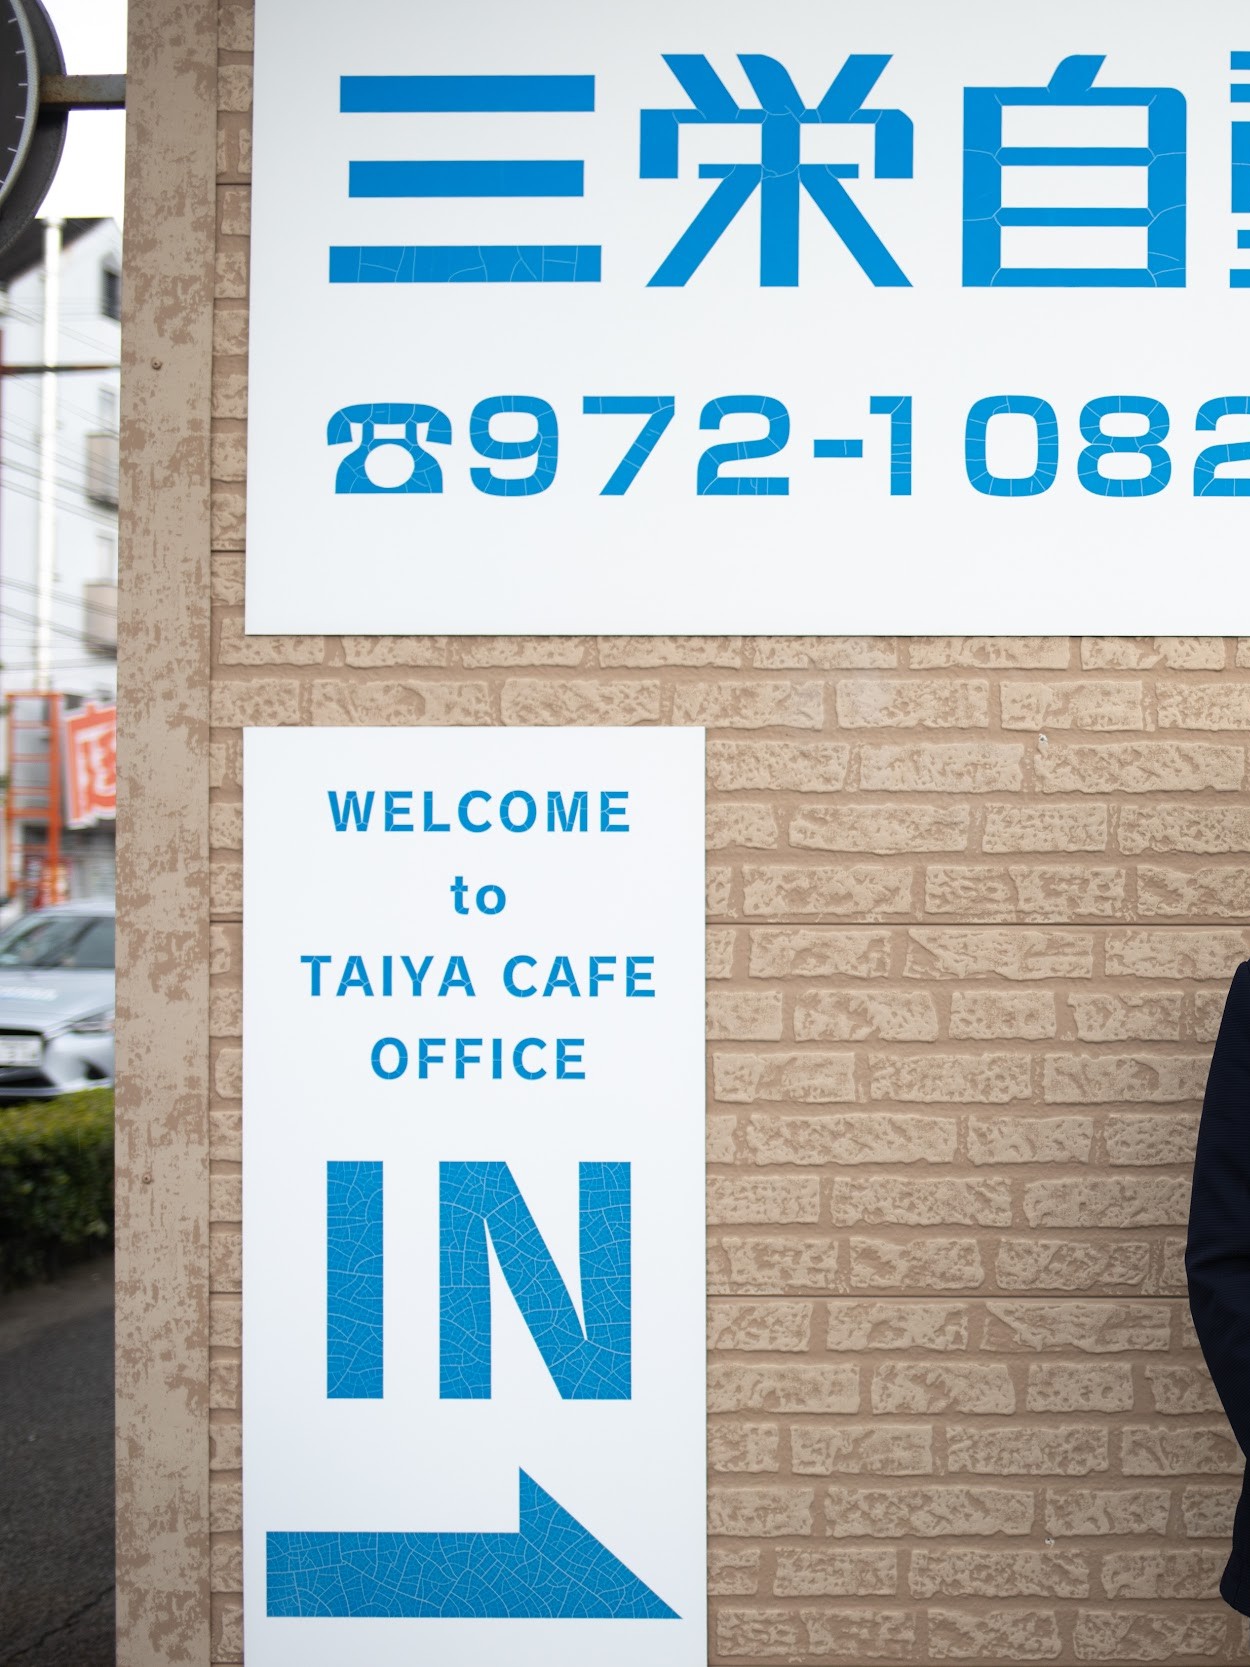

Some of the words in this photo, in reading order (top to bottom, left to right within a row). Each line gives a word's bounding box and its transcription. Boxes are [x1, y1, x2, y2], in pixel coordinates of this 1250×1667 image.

[327, 790, 630, 833] WELCOME
[450, 876, 506, 915] to
[300, 955, 476, 997] TAIYA
[503, 955, 656, 998] CAFE
[371, 1037, 586, 1080] OFFICE
[327, 1160, 632, 1400] IN
